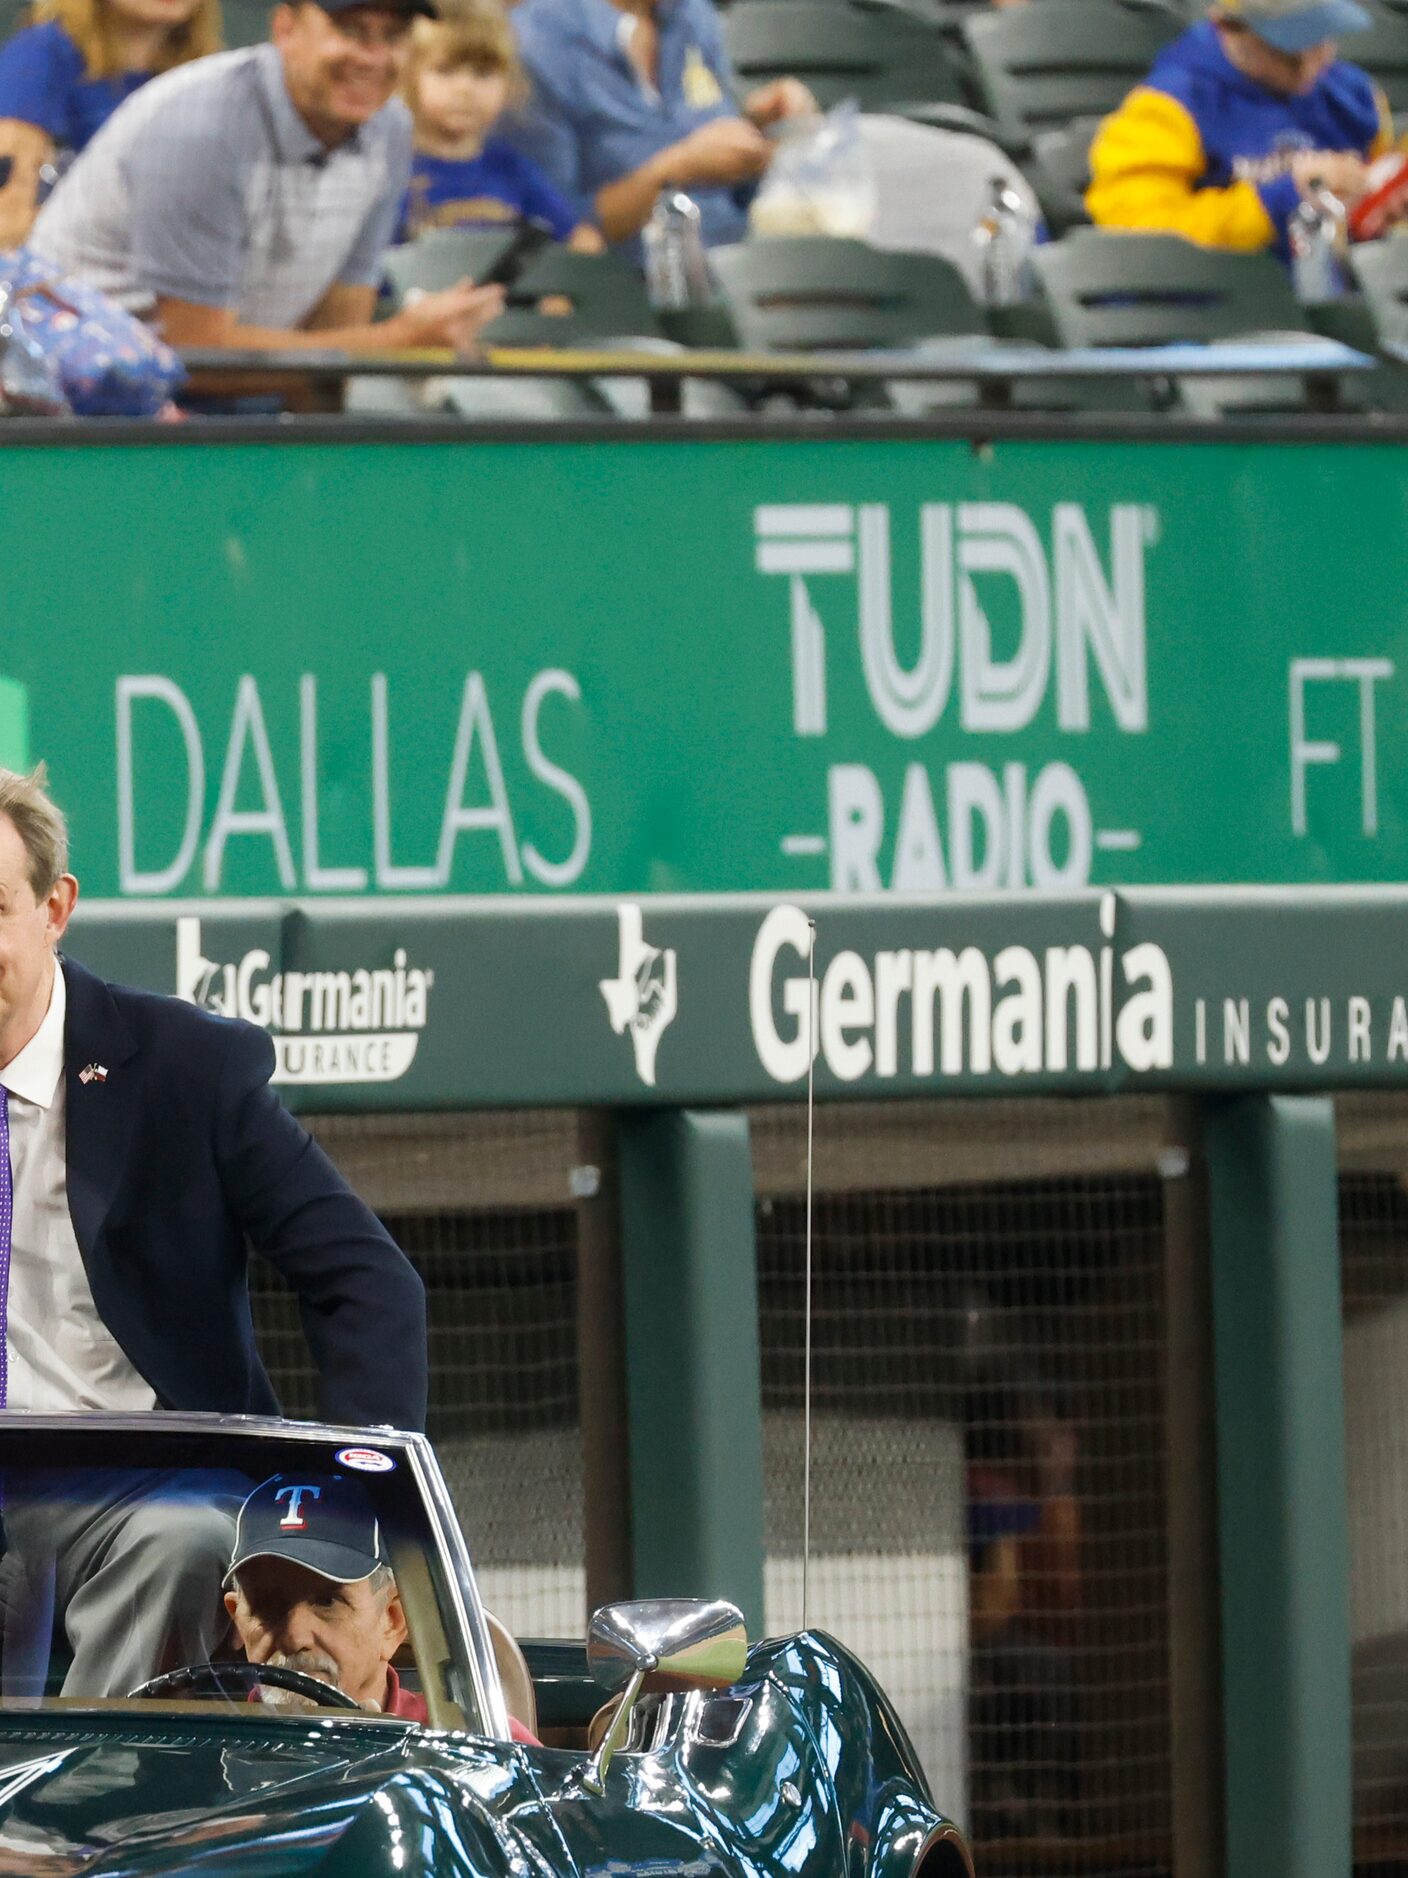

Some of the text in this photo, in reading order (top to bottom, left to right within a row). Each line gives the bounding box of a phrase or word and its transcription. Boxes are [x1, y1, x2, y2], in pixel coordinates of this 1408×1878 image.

[753, 502, 1148, 738] TUDN
[114, 668, 592, 893] DALLAS
[827, 762, 1093, 891] RADIO
[1288, 657, 1395, 839] FT
[284, 1041, 392, 1075] URANCE
[748, 893, 1407, 1083] Germania INSURA
[274, 1485, 321, 1531] T
